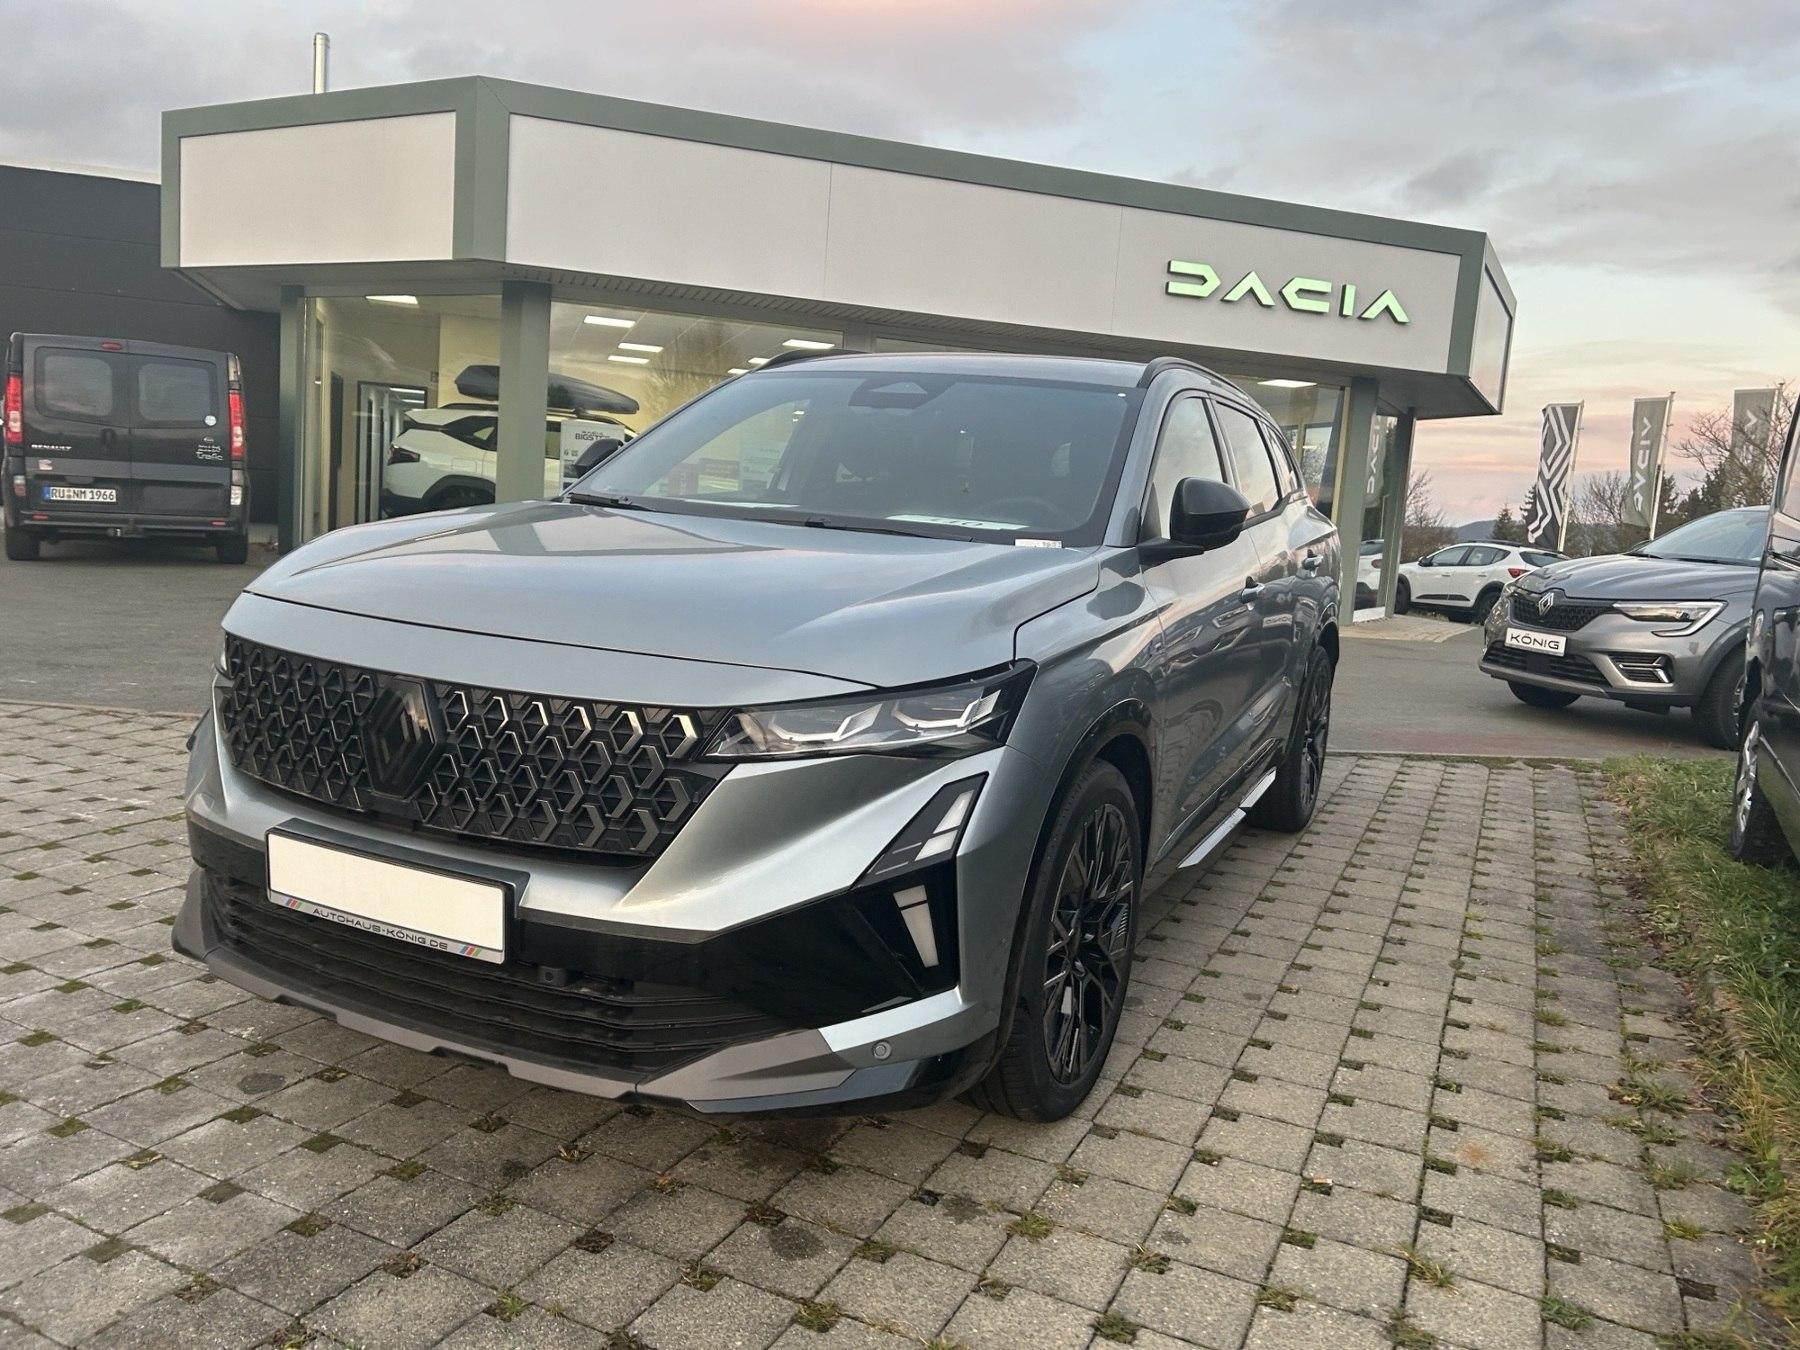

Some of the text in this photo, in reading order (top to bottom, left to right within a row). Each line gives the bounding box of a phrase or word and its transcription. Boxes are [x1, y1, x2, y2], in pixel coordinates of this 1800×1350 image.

[1165, 259, 1411, 324] DACIA
[51, 489, 114, 501] RU NM 1966
[1510, 633, 1560, 650] KÖNIG
[313, 908, 449, 950] AUTOHAUS-KÖNIG.DE
